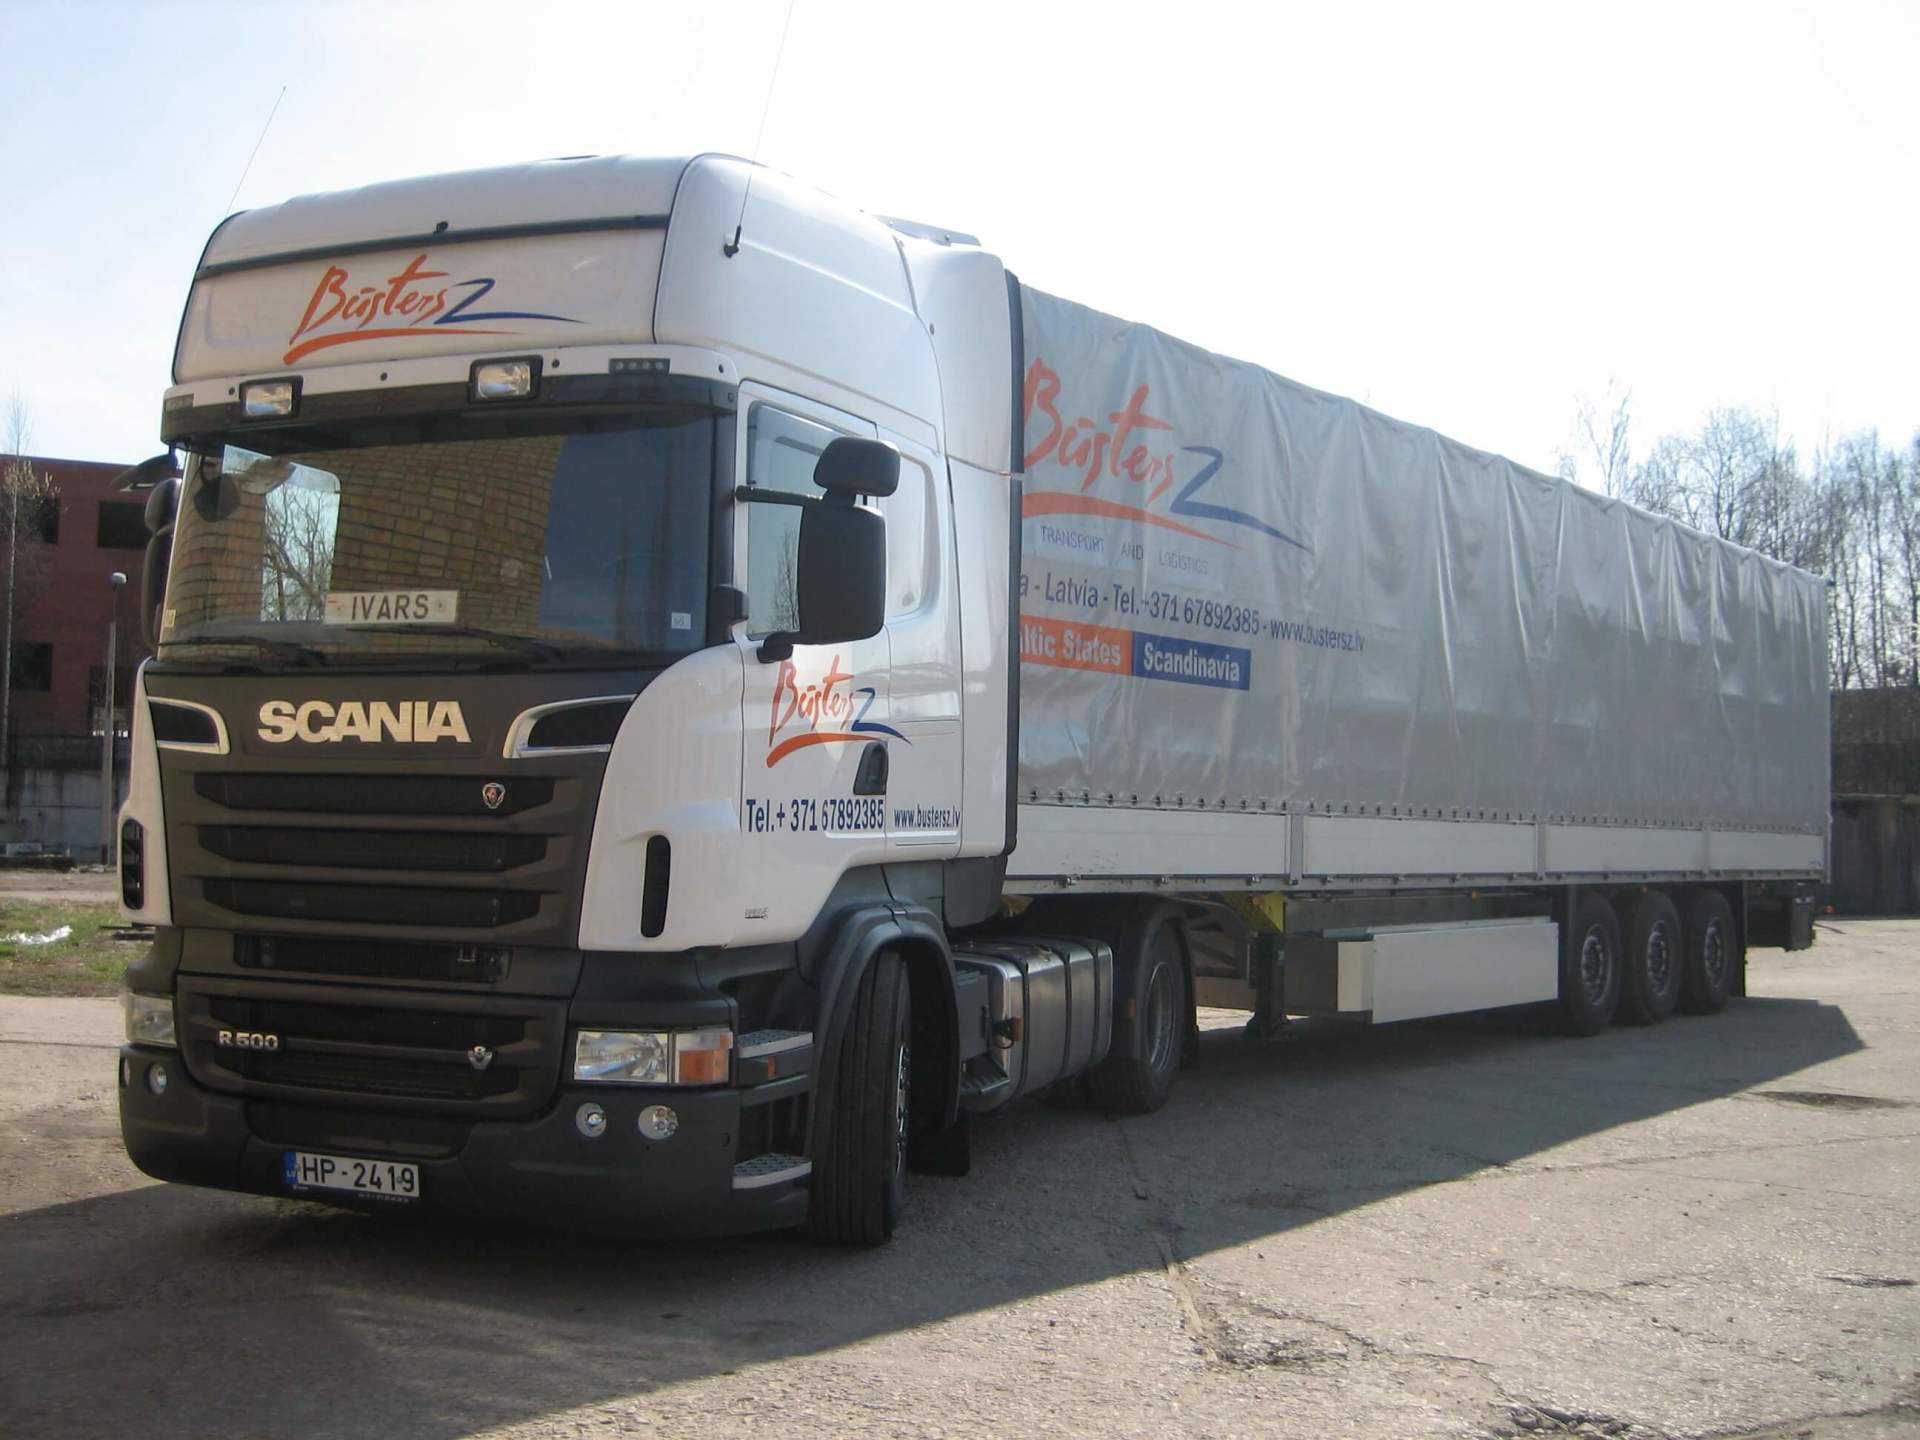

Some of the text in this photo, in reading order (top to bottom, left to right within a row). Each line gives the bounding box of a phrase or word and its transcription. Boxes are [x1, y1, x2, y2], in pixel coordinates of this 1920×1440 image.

[1040, 526, 1208, 575] TRANSPORT AND LOGISTICS
[351, 594, 428, 620] IVARS
[1046, 572, 1098, 608] Latvia
[1184, 597, 1259, 635] 67892385
[1270, 618, 1365, 652] www.bustersz.lv
[1020, 623, 1240, 682] ltic States Scandinavia
[258, 701, 471, 743] SCANIA
[822, 799, 884, 830] 67892385
[894, 804, 960, 828] www.bustersz.lv
[301, 1156, 415, 1193] HP-2419
